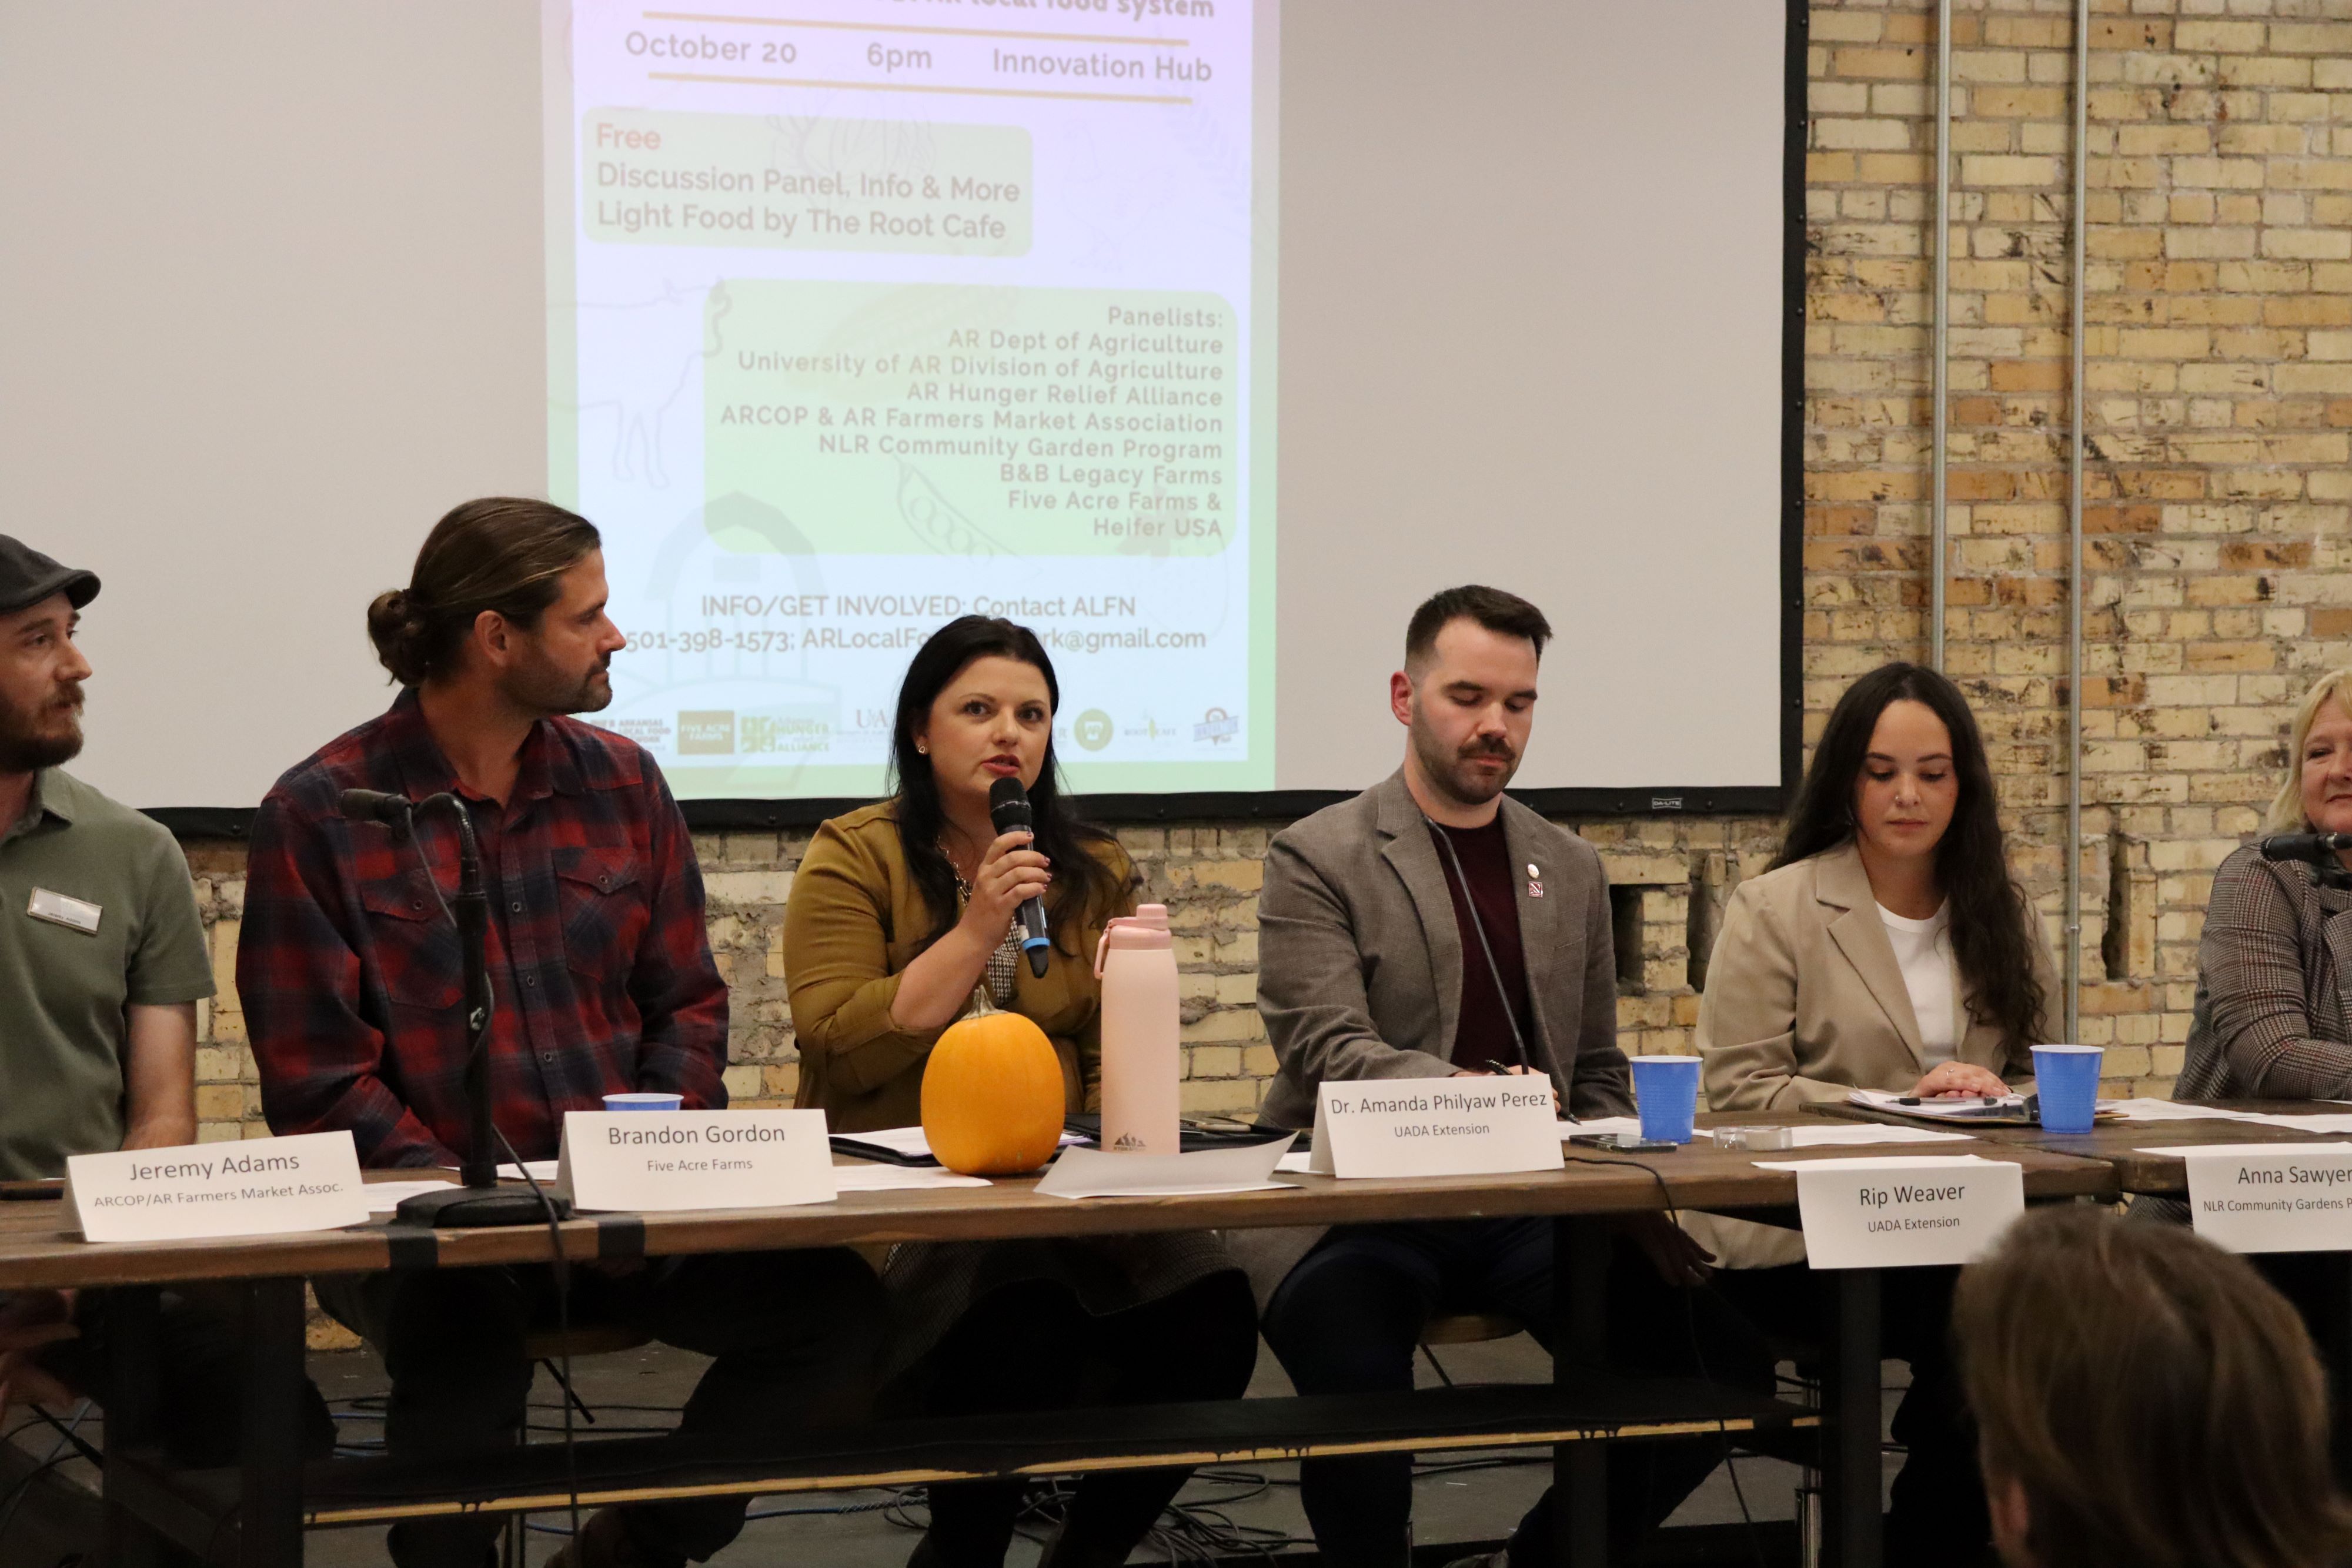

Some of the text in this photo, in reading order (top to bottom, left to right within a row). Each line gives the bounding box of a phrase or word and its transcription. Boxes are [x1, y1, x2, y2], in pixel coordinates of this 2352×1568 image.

[1118, 0, 1214, 22] system
[626, 31, 796, 63] October 20
[867, 42, 932, 73] 6pm
[994, 48, 1211, 81] Innovation Hub
[597, 122, 661, 150] Free
[598, 162, 1020, 202] Discussion Panel, Info & More
[599, 200, 1005, 239] Light Food by The Root Cafe
[1109, 306, 1222, 327] Panelists:
[948, 329, 1223, 357] AR Dept of Agriculture
[739, 350, 1222, 383] University of AR Division of Agriculture
[907, 382, 1222, 407] AR Hunger Relief Alliance
[721, 404, 1222, 433] ARCOP & AR Farmers Market Association
[820, 434, 1221, 463] NLR Community Garden Program
[1001, 463, 1222, 488] B&B Legacy Farms
[1009, 490, 1221, 511] Five Acre Farms &
[1094, 517, 1222, 538] Heifer USA
[703, 596, 1135, 616] INFO/GET INVOLVED: Contact ALFN
[625, 628, 794, 653] 501-398-1573;
[777, 723, 829, 734] HUNGER
[1332, 1093, 1547, 1114] Dr. Amanda Philyaw Perez
[609, 1124, 784, 1144] Brandon Gordon
[1395, 1123, 1489, 1137] UADA Extension
[131, 1155, 299, 1180] Jeremy Adams
[648, 1159, 753, 1171] Five Acre Farms
[2239, 1166, 2352, 1186] Anna Sawyer
[95, 1183, 343, 1206] ARCOP/AR Farmers Market Assoc.
[1860, 1186, 1965, 1208] Rip Weaver
[2204, 1201, 2224, 1211] NLR
[2228, 1200, 2292, 1212] Community
[2296, 1198, 2343, 1209] Gardens
[1869, 1216, 1959, 1232] UADA Extension
